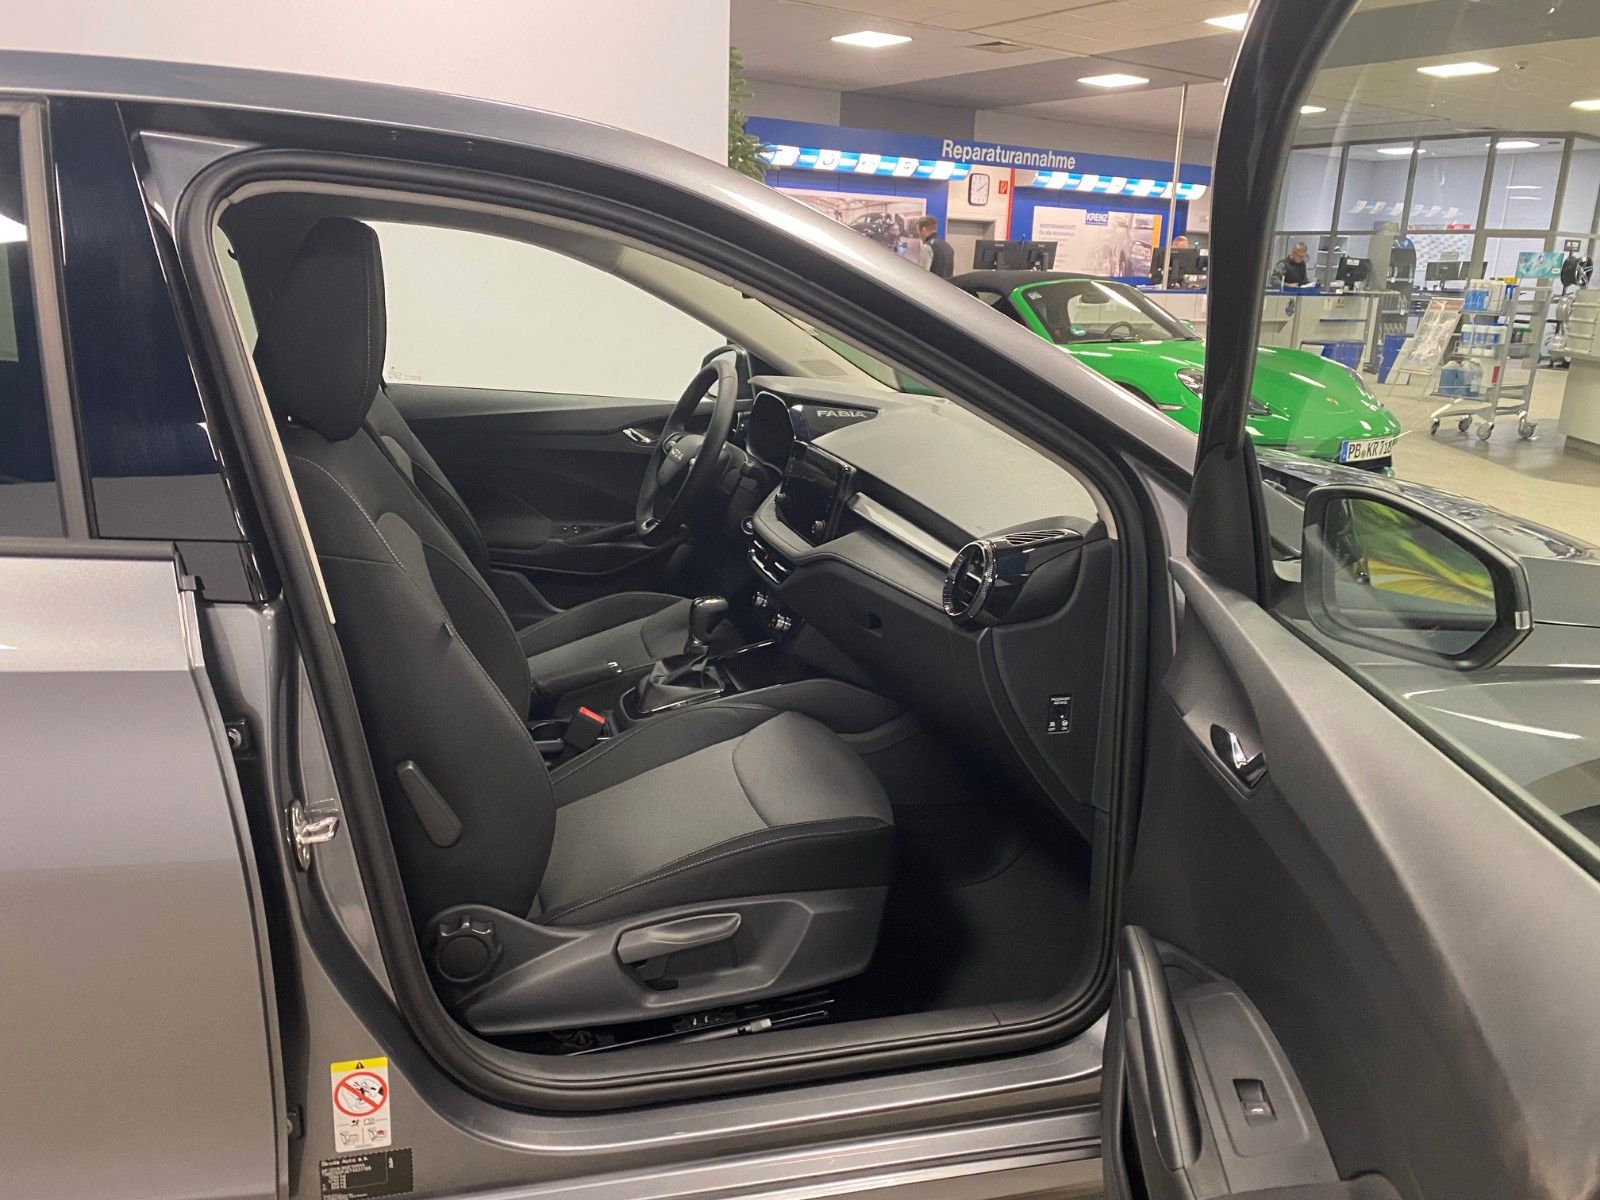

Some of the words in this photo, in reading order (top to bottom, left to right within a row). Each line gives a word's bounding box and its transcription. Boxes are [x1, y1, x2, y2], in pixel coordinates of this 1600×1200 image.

[941, 138, 1076, 170] Reparaturannahme
[1086, 212, 1108, 223] KRENZ
[816, 410, 867, 418] FABIA
[1348, 443, 1361, 459] PB
[1366, 440, 1379, 457] KR
